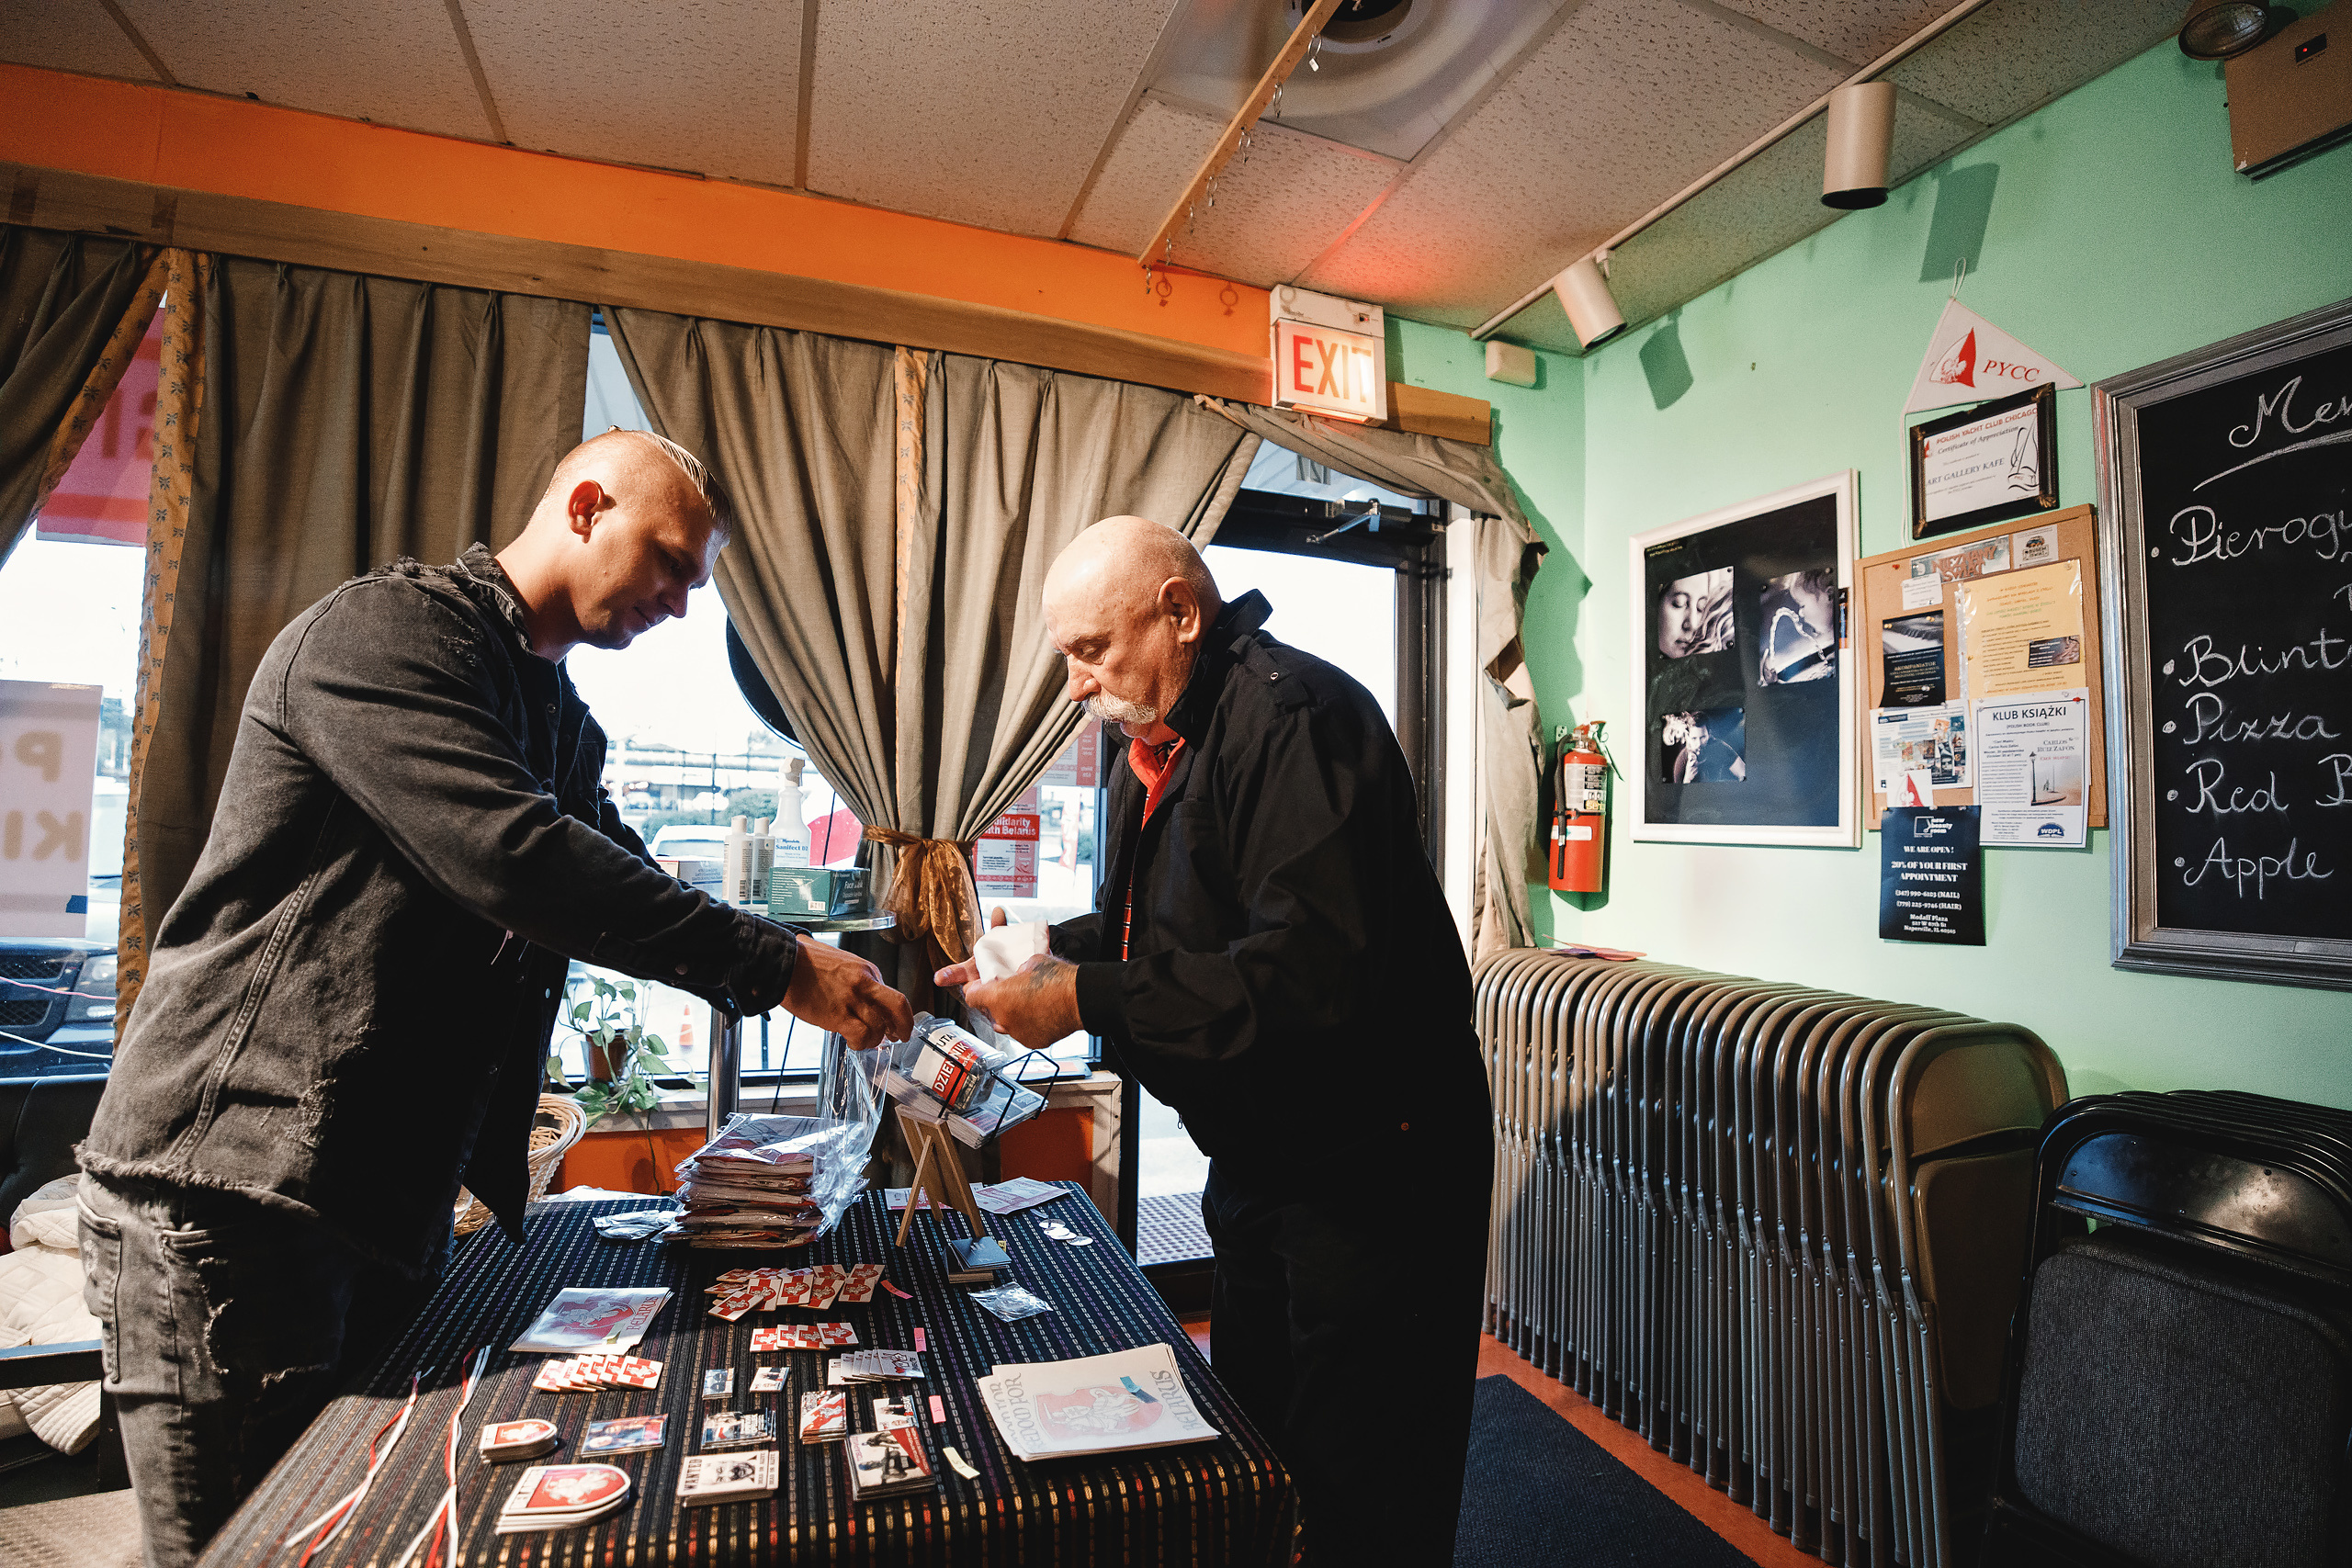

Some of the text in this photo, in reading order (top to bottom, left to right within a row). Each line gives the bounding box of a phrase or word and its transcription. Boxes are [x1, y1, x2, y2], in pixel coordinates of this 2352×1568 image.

[1293, 333, 1372, 403] EXIT
[1983, 359, 2041, 382] PYCC
[1937, 433, 1961, 445] POLISH
[1962, 425, 1983, 436] YACHT
[1984, 418, 2003, 430] CLUB
[1938, 441, 1969, 455] Certificate
[1978, 425, 2019, 443] Appreciation
[1927, 475, 1942, 486] ART
[1943, 465, 1981, 481] GALLERY
[1983, 457, 2005, 470] KAFE
[1993, 705, 2066, 720] KLUB KSIĄŻKI
[2183, 693, 2340, 744] Pizza
[2185, 759, 2290, 814] Red
[994, 817, 1031, 828] lidarity
[1002, 826, 1036, 836] Belarus
[1901, 873, 1959, 883] APPOINTMENT
[1906, 862, 1918, 870] OF
[1918, 862, 1942, 871] YOUR
[1942, 863, 1968, 871] FIRST
[2183, 837, 2334, 899] Apple
[626, 1296, 659, 1331] BELARUS
[1005, 1372, 1030, 1405] FOR
[1149, 1370, 1202, 1432] BELARUS
[684, 1459, 703, 1491] WANTED
